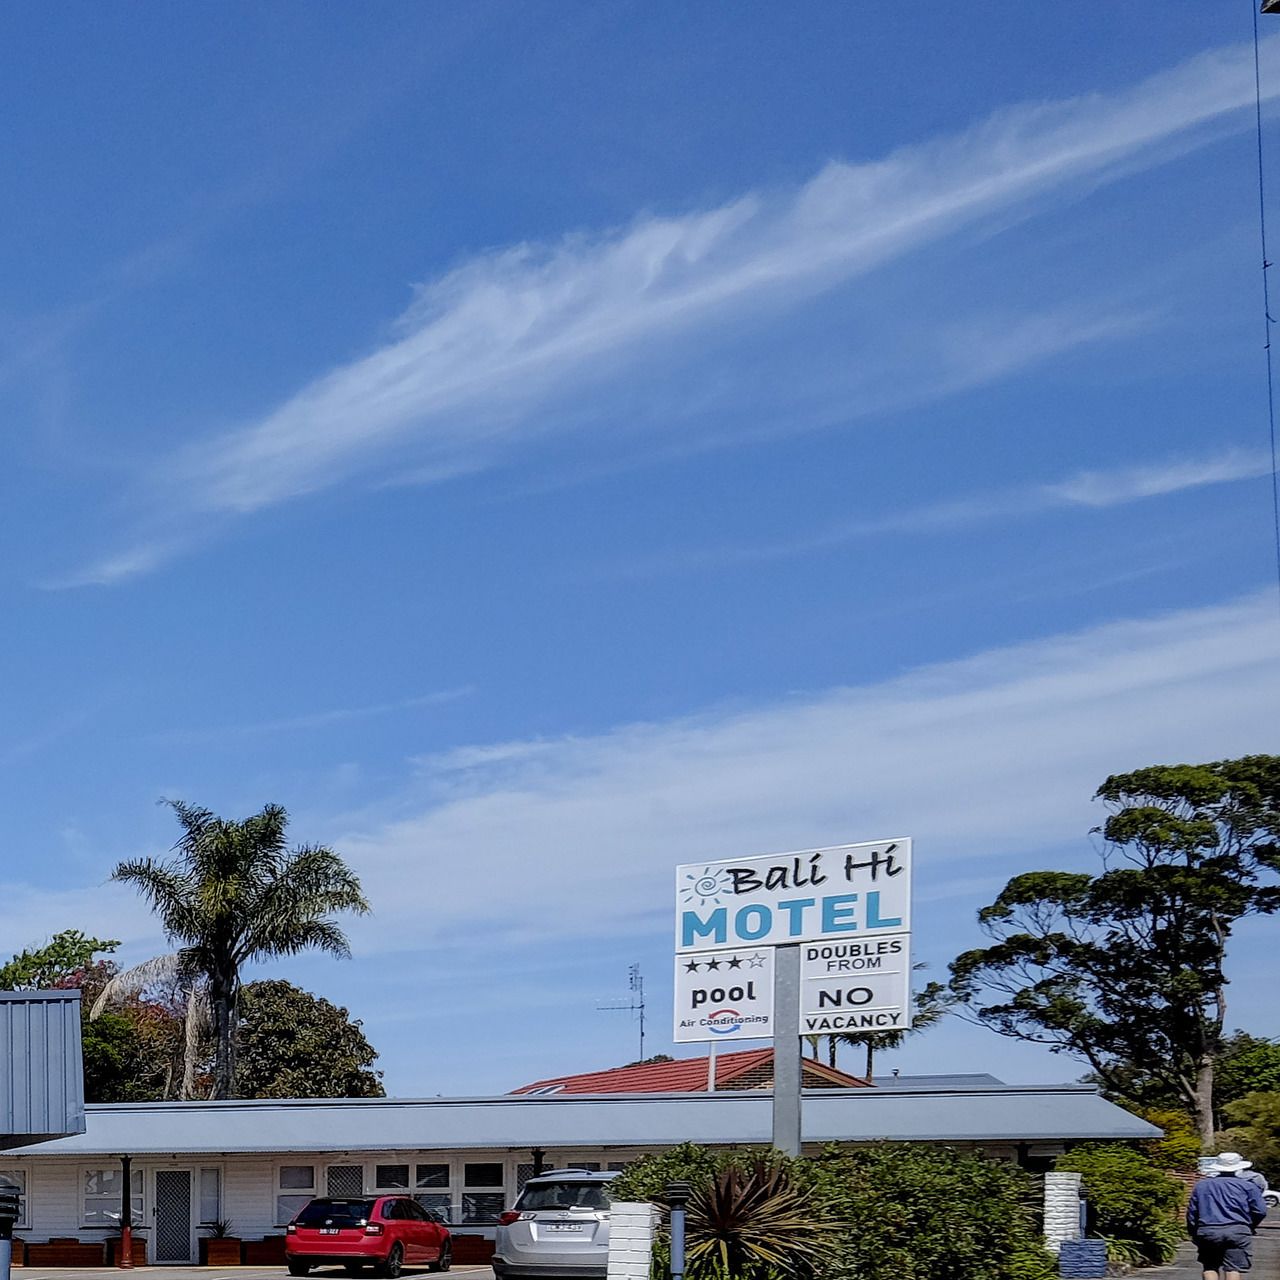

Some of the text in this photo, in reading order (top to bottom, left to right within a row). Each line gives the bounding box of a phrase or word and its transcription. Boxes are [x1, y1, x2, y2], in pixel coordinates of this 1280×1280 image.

[726, 844, 903, 895] Bali Hi
[682, 890, 902, 947] MOTEL
[807, 940, 902, 961] DOUBLES
[827, 957, 881, 972] FROM
[691, 981, 756, 1008] pool
[819, 987, 873, 1008] NO
[680, 1014, 769, 1027] Air Conditioning
[806, 1013, 902, 1031] VACANCY
